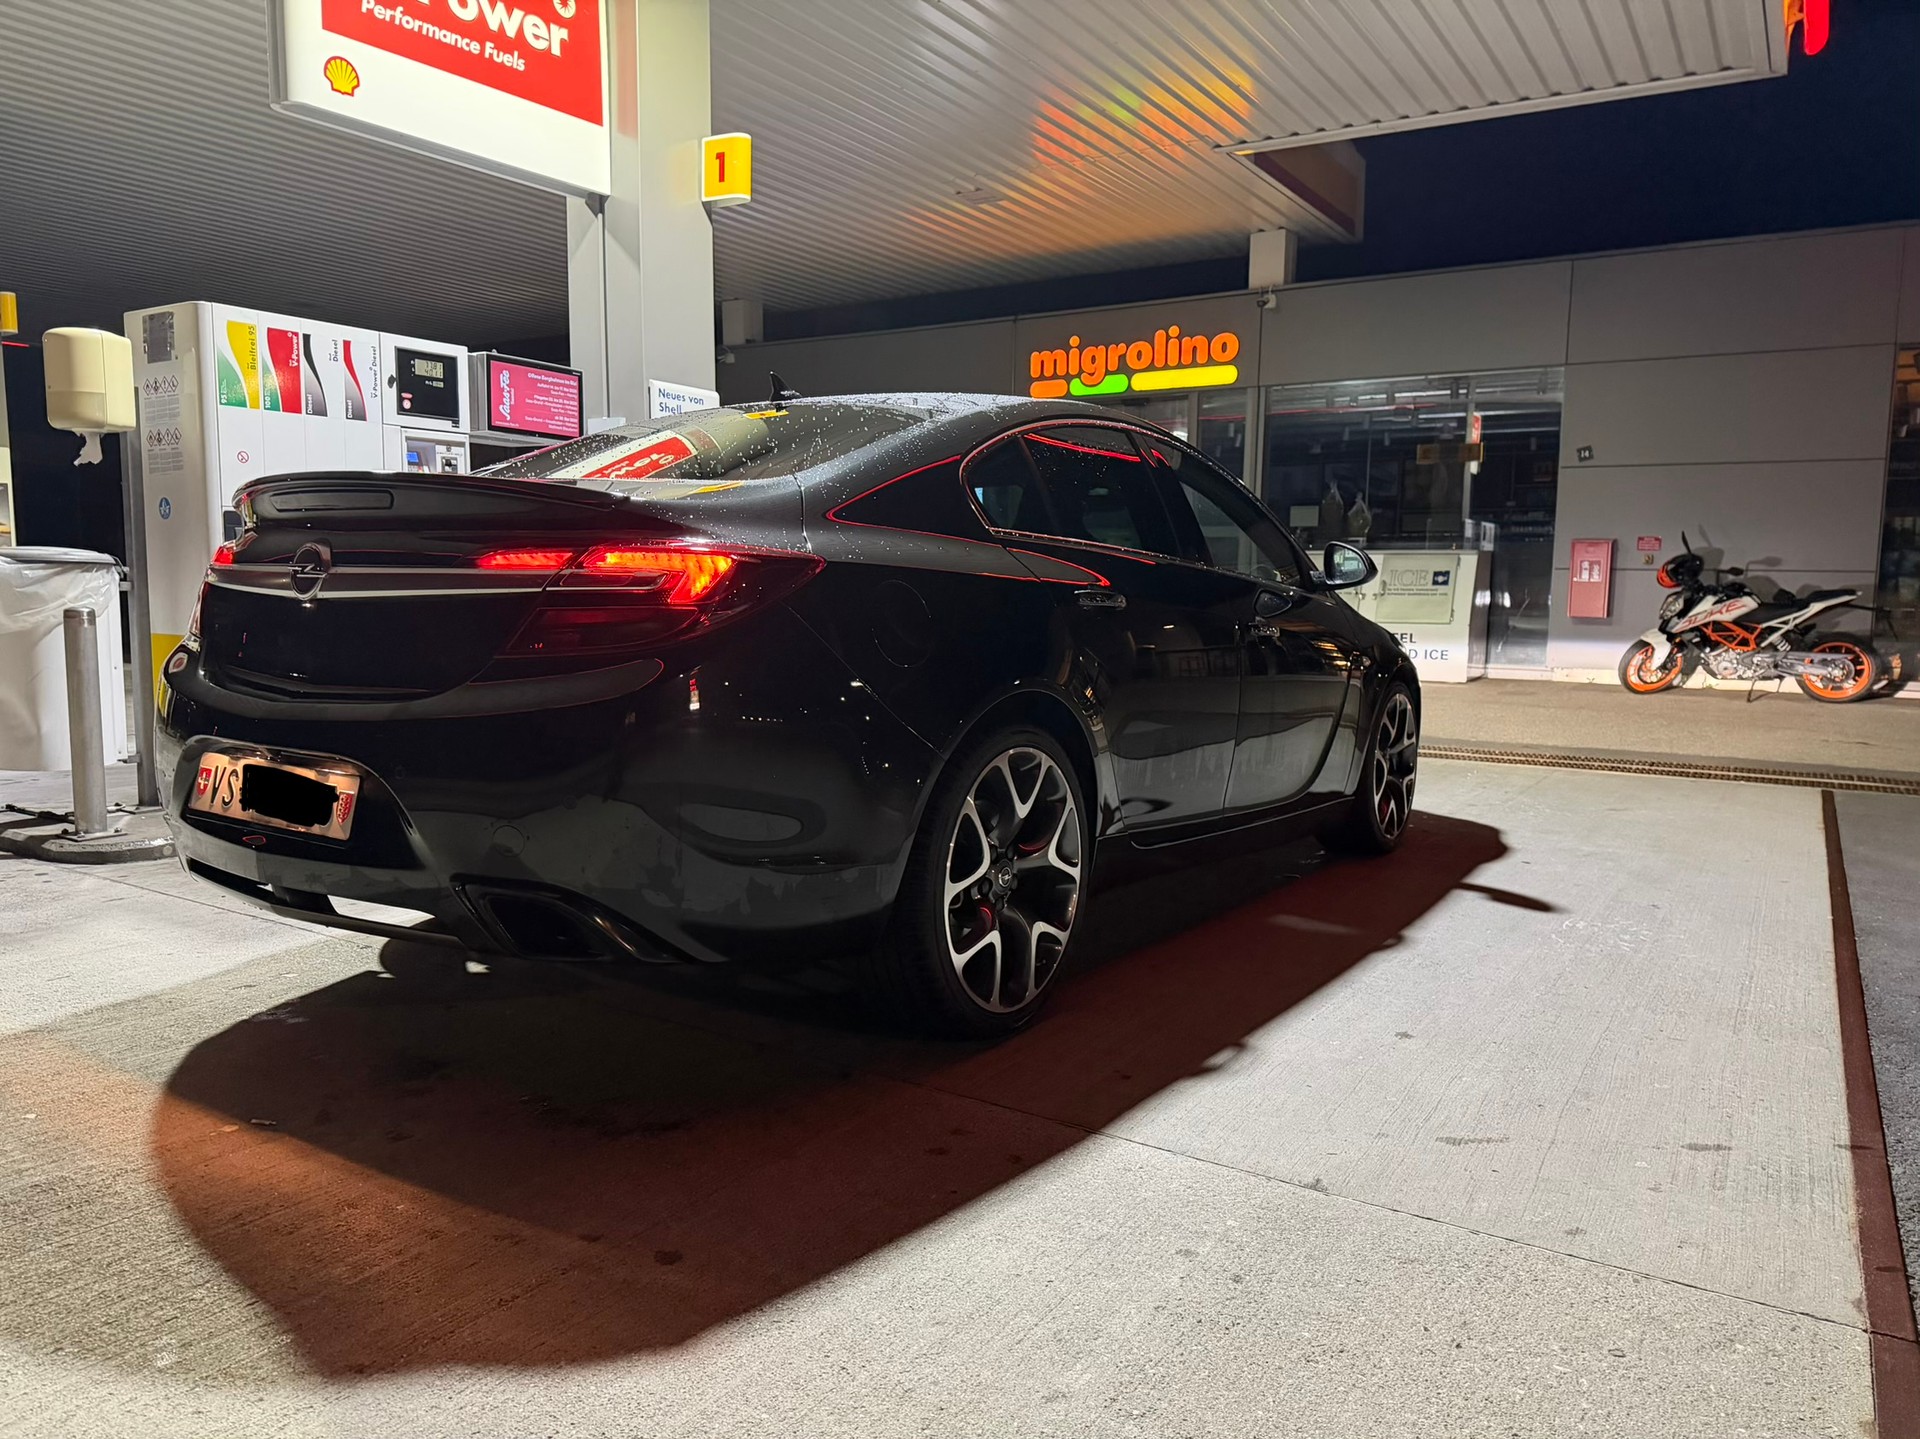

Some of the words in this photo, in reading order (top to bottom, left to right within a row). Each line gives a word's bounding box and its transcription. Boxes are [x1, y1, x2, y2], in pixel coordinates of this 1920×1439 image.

[361, 0, 481, 54] Performance
[484, 42, 526, 72] Fuels
[416, 0, 569, 57] ower
[715, 151, 726, 184] 1
[331, 339, 339, 362] Diesel
[370, 345, 378, 367] Diesel
[1030, 325, 1240, 386] migrolino
[658, 387, 686, 402] Neues
[688, 396, 704, 406] von
[658, 401, 683, 415] Shell
[1388, 569, 1429, 587] ICE
[1393, 632, 1417, 644] EL
[1424, 649, 1449, 661] ICE
[210, 764, 240, 807] VS
